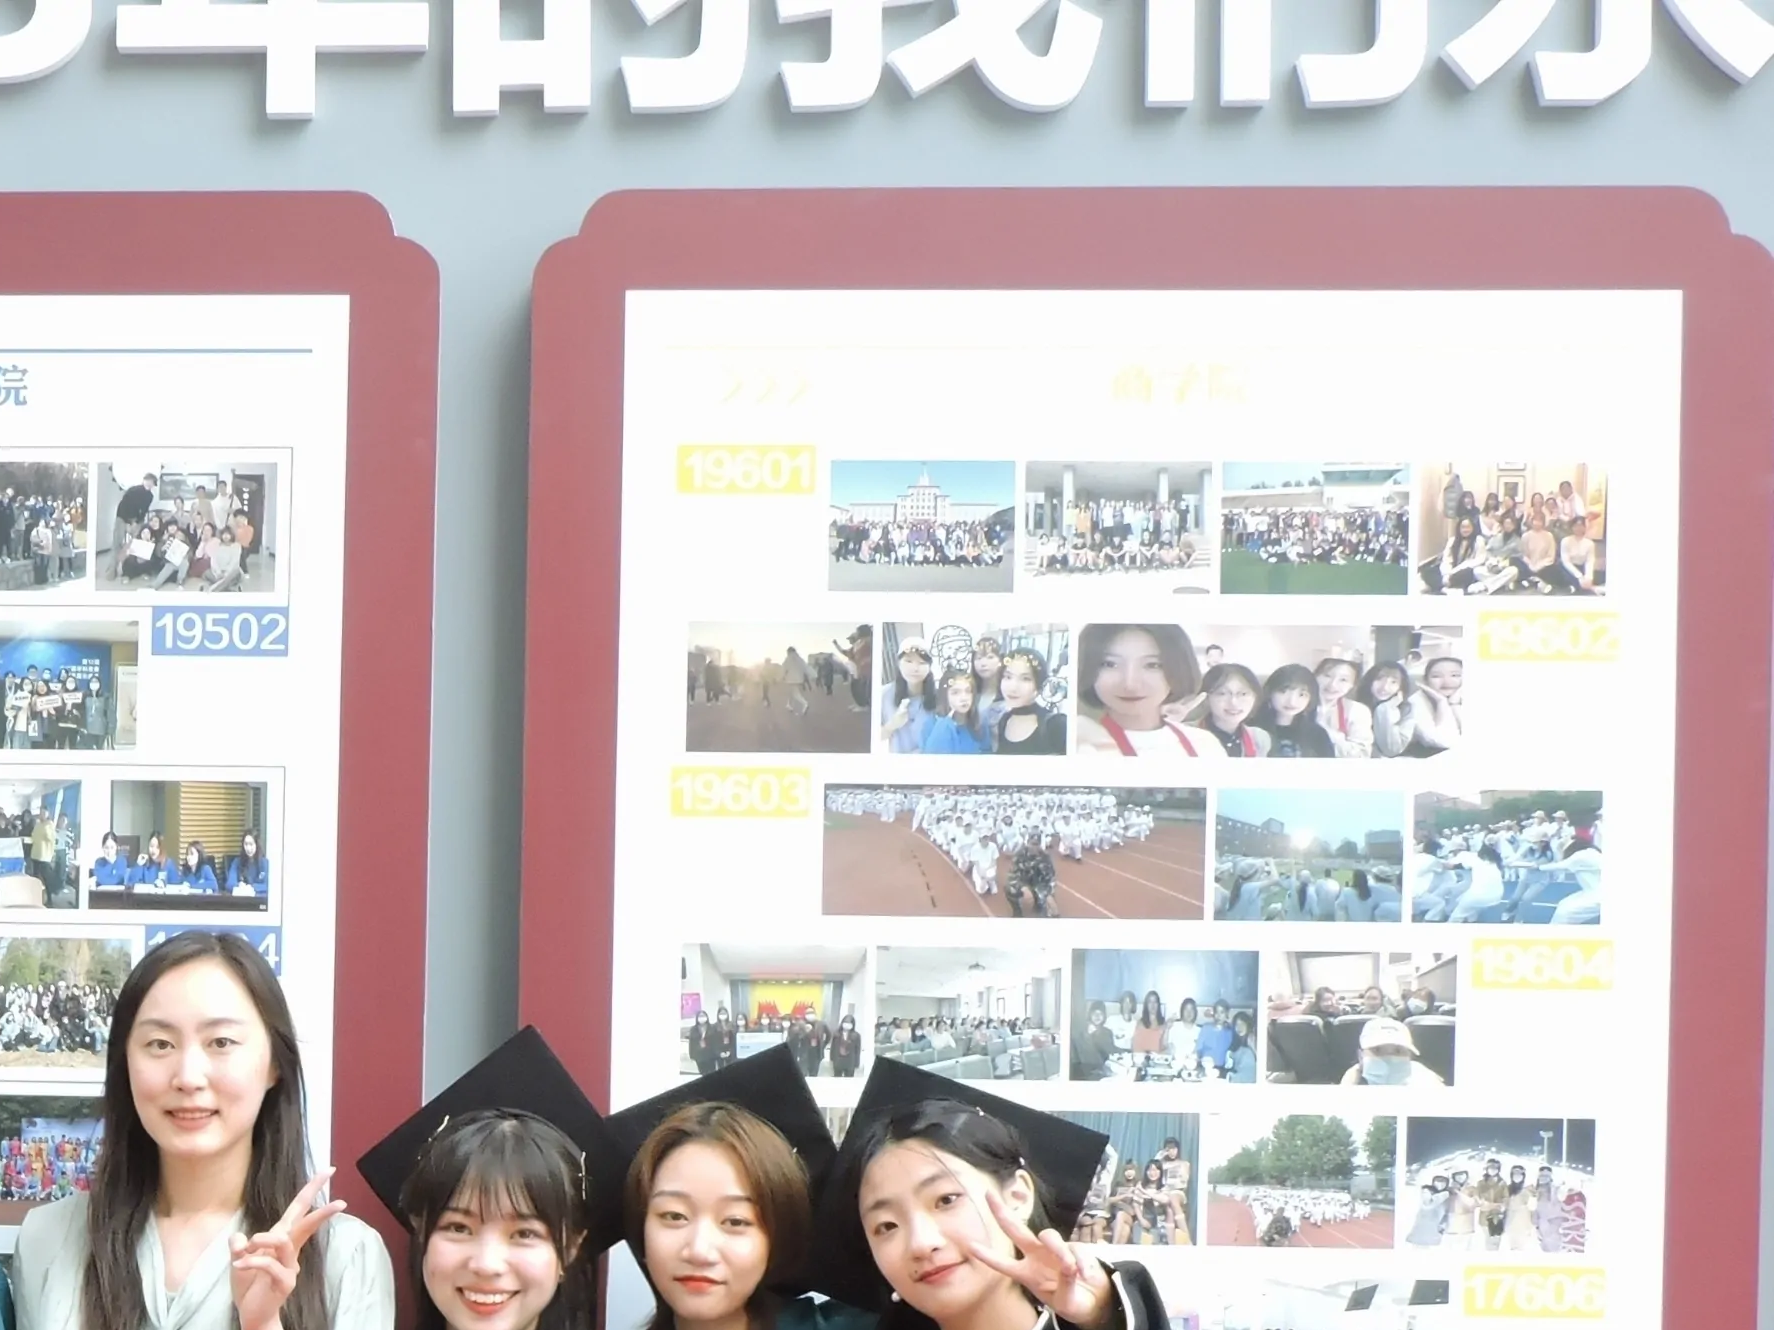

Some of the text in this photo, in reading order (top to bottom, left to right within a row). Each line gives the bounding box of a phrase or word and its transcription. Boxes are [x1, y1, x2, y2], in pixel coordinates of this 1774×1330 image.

[683, 450, 814, 490] 19601
[154, 612, 287, 651] 19502
[1479, 616, 1621, 656] 19602
[673, 772, 810, 812] 19603
[1472, 944, 1614, 984] 19604
[1466, 1272, 1606, 1312] 17606
